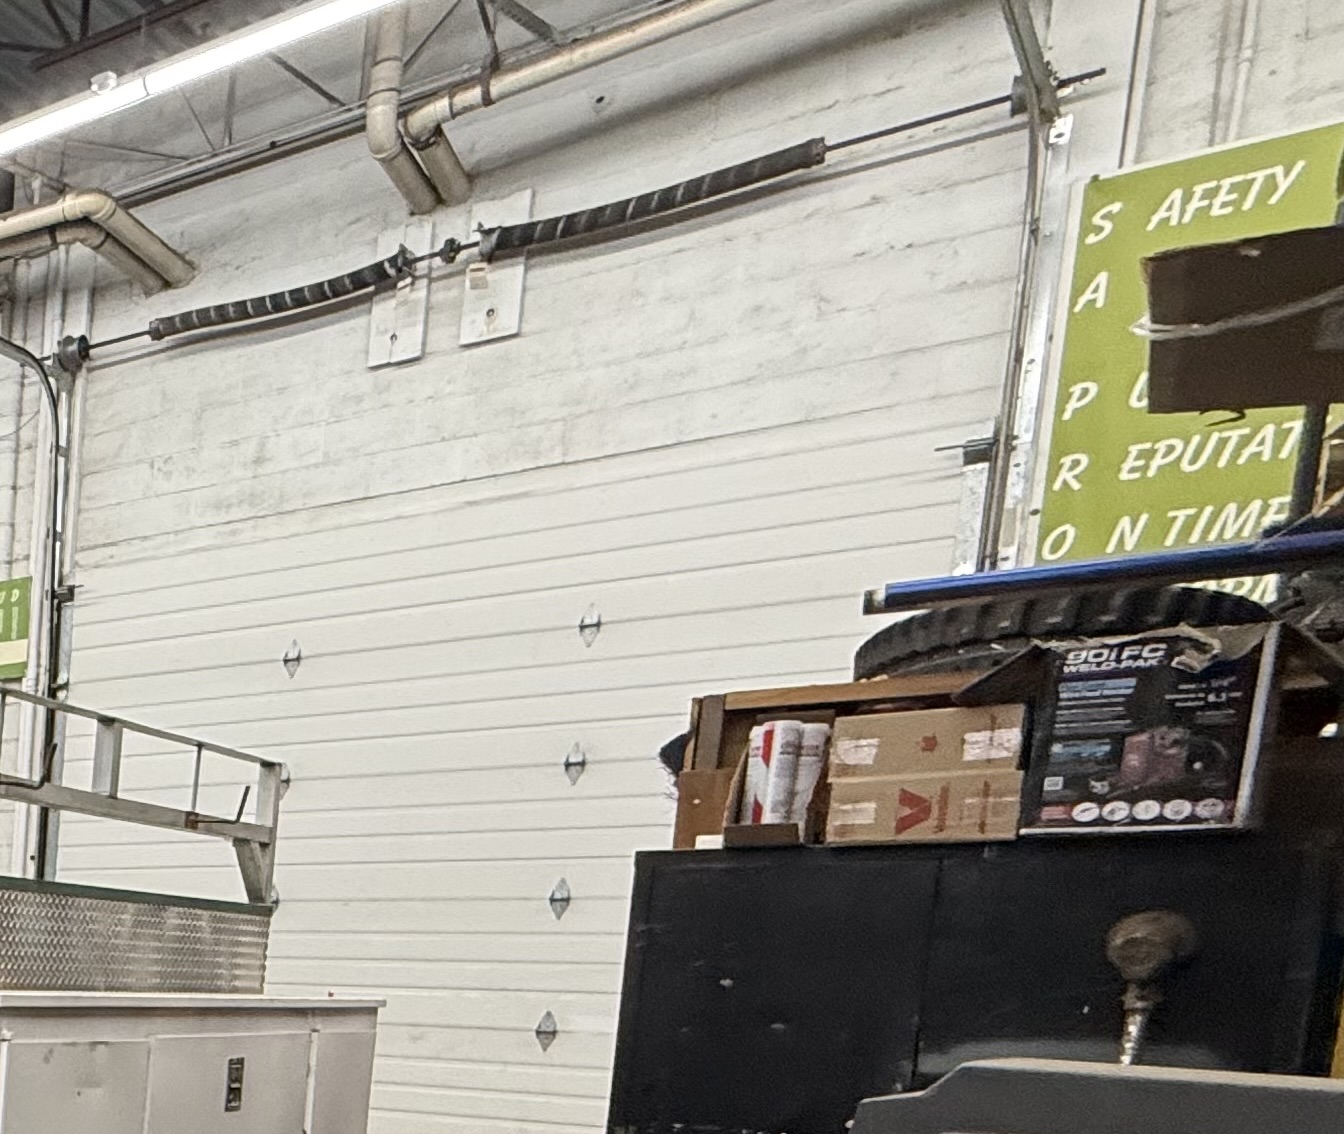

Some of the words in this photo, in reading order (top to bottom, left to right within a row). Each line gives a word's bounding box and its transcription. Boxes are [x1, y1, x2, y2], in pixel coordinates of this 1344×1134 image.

[1084, 201, 1124, 245] S
[1146, 160, 1306, 232] AFETY
[1073, 271, 1109, 314] A
[1061, 381, 1098, 421] P
[1052, 453, 1089, 491] R
[1118, 419, 1304, 481] EPUTAT
[1040, 524, 1076, 561] O
[1105, 513, 1149, 554] N
[1062, 658, 1160, 674] WELD-PAK
[1120, 643, 1168, 659] FC
